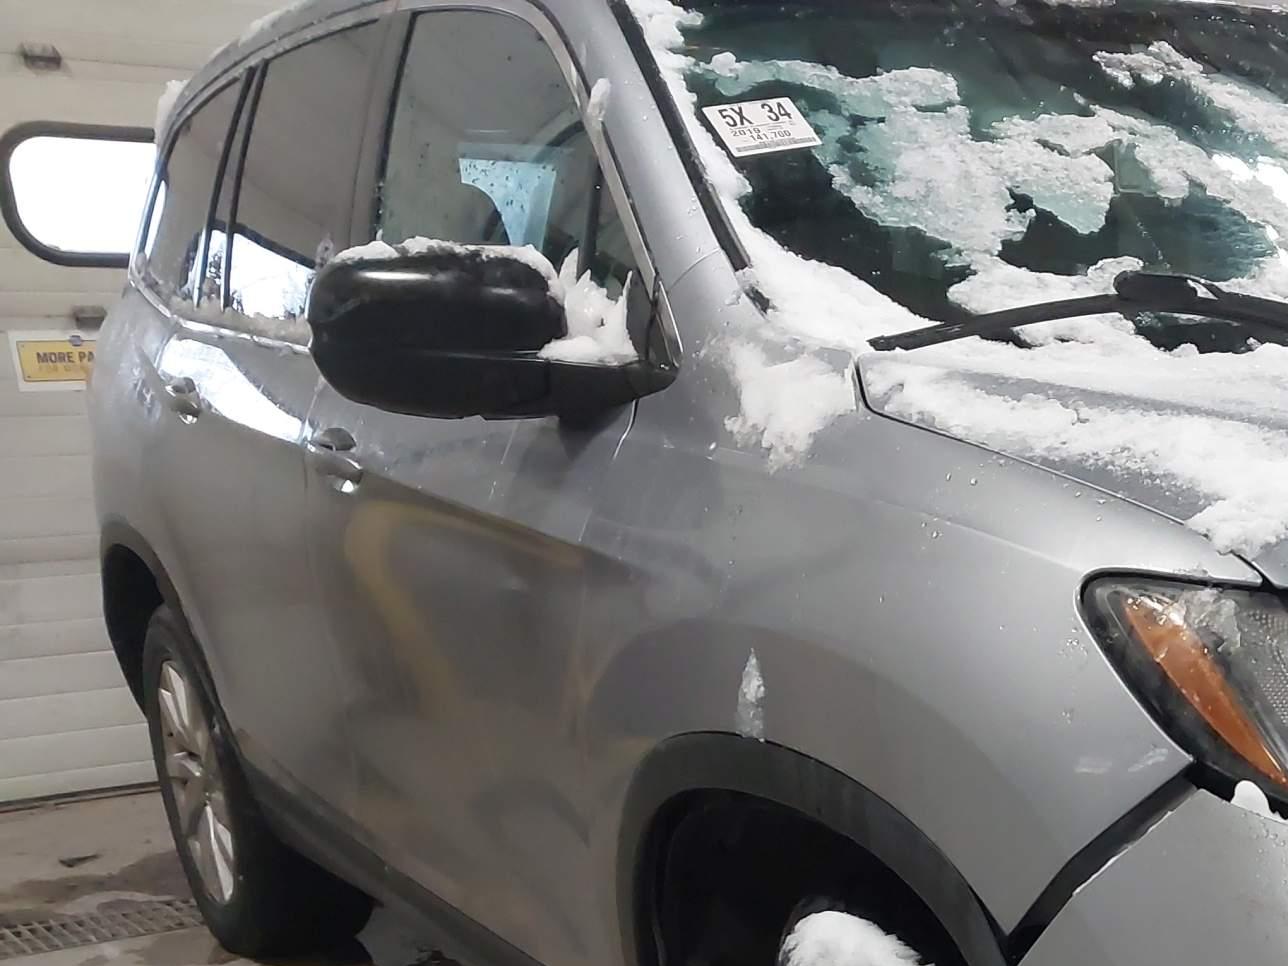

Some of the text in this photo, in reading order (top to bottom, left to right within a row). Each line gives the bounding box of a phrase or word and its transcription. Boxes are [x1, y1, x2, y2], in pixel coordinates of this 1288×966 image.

[718, 105, 754, 127] 5X
[761, 102, 793, 122] 34
[730, 127, 761, 137] 2019
[36, 351, 75, 364] MORE
